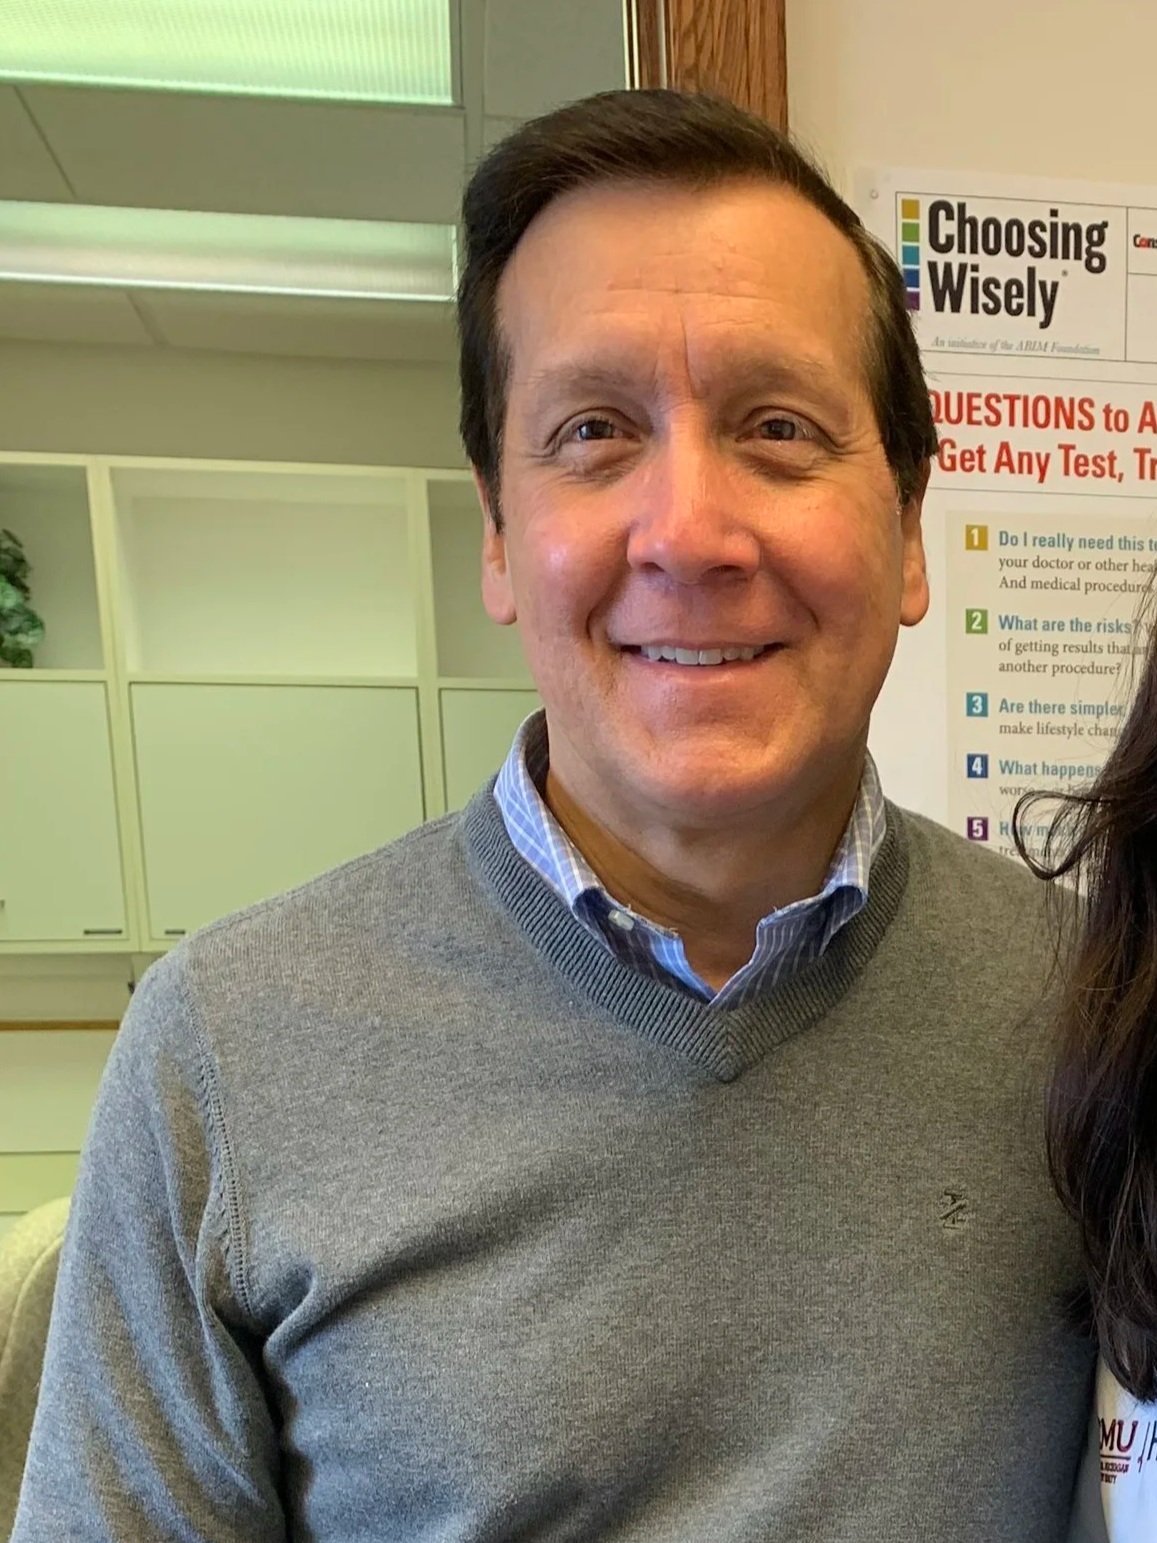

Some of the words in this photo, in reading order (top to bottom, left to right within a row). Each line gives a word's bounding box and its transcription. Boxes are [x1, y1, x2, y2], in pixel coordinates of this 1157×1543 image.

[928, 199, 1108, 274] Choosing
[927, 260, 1060, 330] Wisely
[927, 389, 1097, 432] QUESTIONS
[1103, 403, 1130, 434] to
[936, 438, 987, 474] Get
[993, 441, 1052, 485] Any
[1057, 444, 1125, 484] Test,
[999, 530, 1019, 548] Do
[1032, 532, 1074, 552] really
[1078, 534, 1114, 551] need
[1118, 535, 1145, 552] this
[998, 556, 1029, 572] your
[1032, 555, 1075, 570] doctor
[1077, 560, 1093, 571] or
[1094, 557, 1130, 572] other
[999, 576, 1027, 590] And
[1031, 577, 1082, 592] medical
[998, 615, 1039, 632] What
[1042, 619, 1067, 632] are
[1069, 617, 1093, 633] the
[998, 638, 1014, 652] of
[1015, 640, 1060, 657] getting
[1062, 640, 1105, 655] results
[1107, 641, 1131, 655] that
[998, 659, 1049, 674] another
[1051, 661, 1122, 678] procedure?
[999, 698, 1025, 715] Are
[1029, 700, 1066, 716] there
[998, 721, 1034, 736] make
[1036, 721, 1085, 740] lifestyle
[1087, 723, 1118, 738] chan
[998, 759, 1038, 776] What
[999, 821, 1033, 837] Hw
